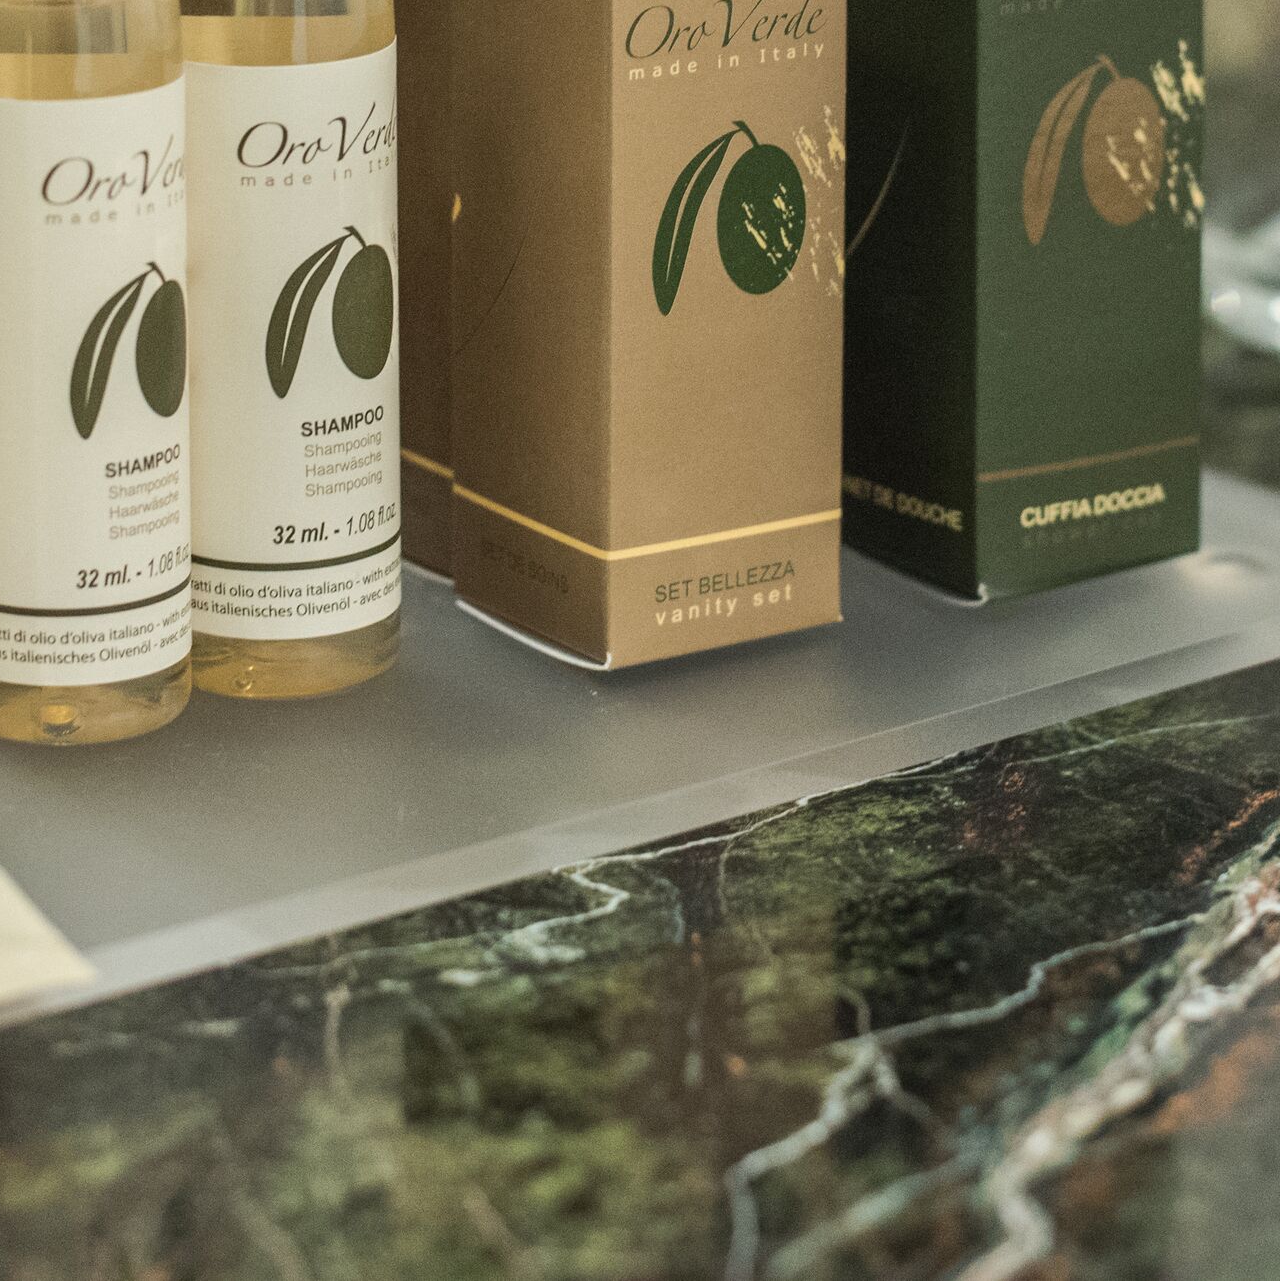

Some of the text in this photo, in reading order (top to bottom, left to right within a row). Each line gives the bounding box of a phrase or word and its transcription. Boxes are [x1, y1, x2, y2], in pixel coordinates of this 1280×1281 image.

[624, 4, 718, 60] Oro
[629, 42, 825, 81] made in Italy
[236, 121, 332, 169] Oro
[41, 156, 135, 207] Oro
[240, 156, 391, 187] made in Ita
[44, 208, 118, 225] made
[136, 201, 155, 216] in
[300, 405, 385, 437] SHAMPOO
[105, 443, 181, 478] SHAMPOO
[303, 430, 382, 458] Shampooing
[304, 450, 382, 478] Haarwäsche
[304, 469, 383, 497] Shampooing
[1020, 482, 1166, 528] CUFFIA DOCCIA
[272, 524, 296, 545] 32
[300, 521, 329, 543] ml.
[345, 509, 376, 537] 1.08
[76, 568, 99, 589] 32
[103, 564, 131, 586] ml.
[147, 550, 174, 578] 1.08
[654, 559, 796, 603] SET BELLEZZA
[190, 577, 212, 593] ratti
[214, 582, 226, 596] di
[229, 584, 254, 598] olio
[258, 585, 302, 599] d'oliva
[306, 579, 354, 597] italiano
[190, 597, 209, 612] aus
[211, 601, 293, 618] italienisches
[296, 596, 350, 617] Olivenöl
[360, 588, 382, 606] avec
[655, 584, 793, 626] vanity set
[13, 629, 26, 643] di
[29, 630, 56, 645] olio
[59, 630, 105, 646] d'oliva
[109, 622, 154, 641] italiano
[10, 646, 96, 664] italienisches
[98, 640, 152, 662] Olivenöl
